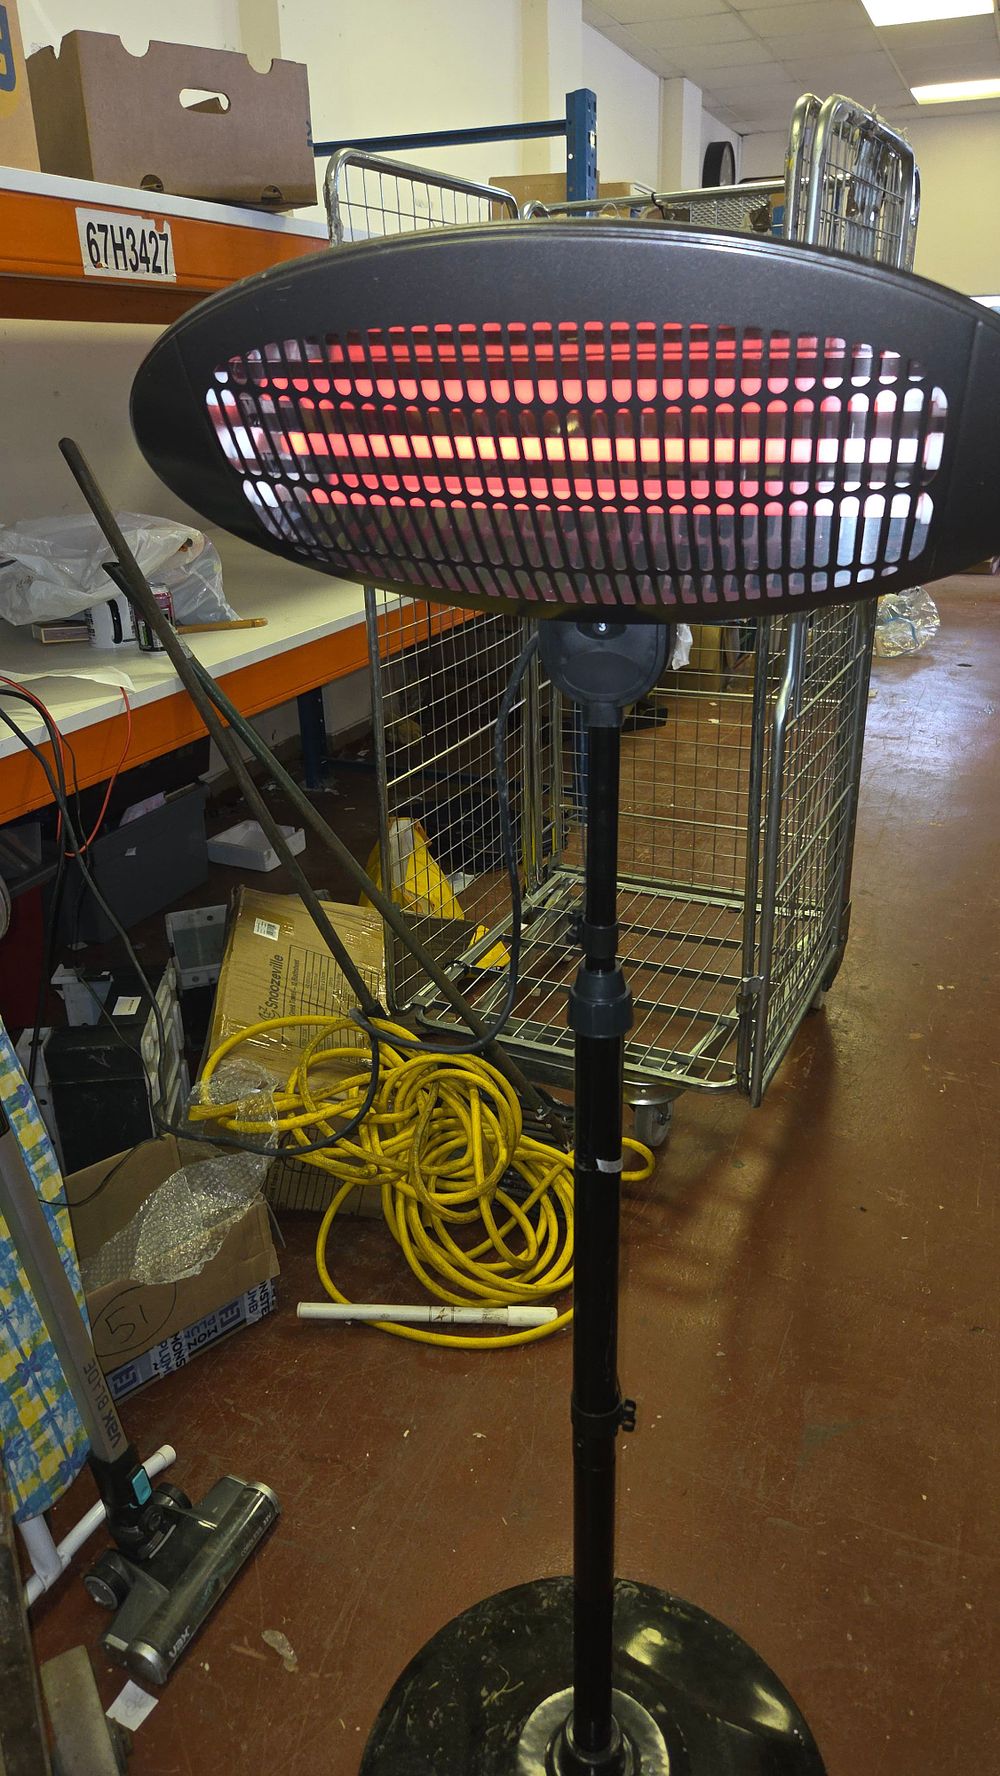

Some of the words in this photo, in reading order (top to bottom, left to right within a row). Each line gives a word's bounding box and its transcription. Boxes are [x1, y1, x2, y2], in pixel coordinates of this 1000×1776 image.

[86, 221, 168, 275] 67H3427
[265, 954, 284, 1010] Snoozeville
[259, 1280, 270, 1316] NSTE
[83, 1359, 109, 1410] BLADE
